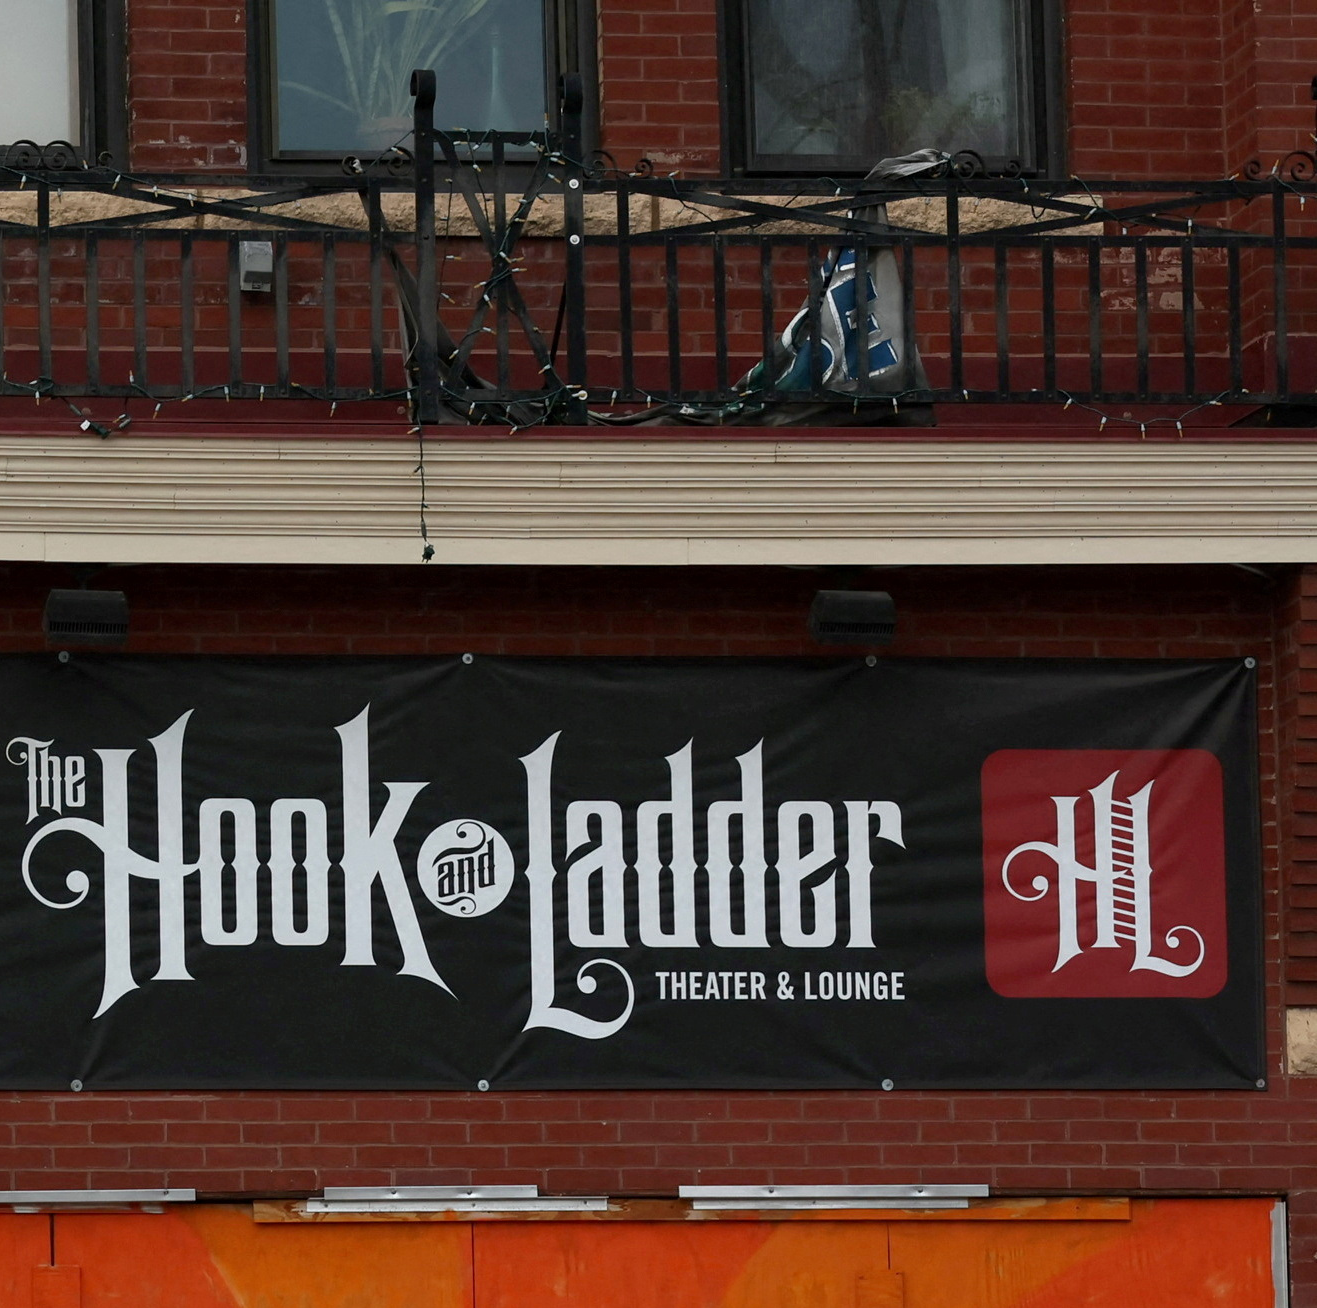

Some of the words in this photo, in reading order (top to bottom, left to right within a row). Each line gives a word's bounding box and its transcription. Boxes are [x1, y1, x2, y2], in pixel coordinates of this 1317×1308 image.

[6, 736, 85, 826] The
[21, 700, 460, 1020] Hook
[435, 834, 496, 899] and
[518, 729, 907, 1040] Ladder
[655, 970, 766, 1001] THEATER
[776, 970, 795, 1001] &
[804, 970, 906, 1001] LOUNGE
